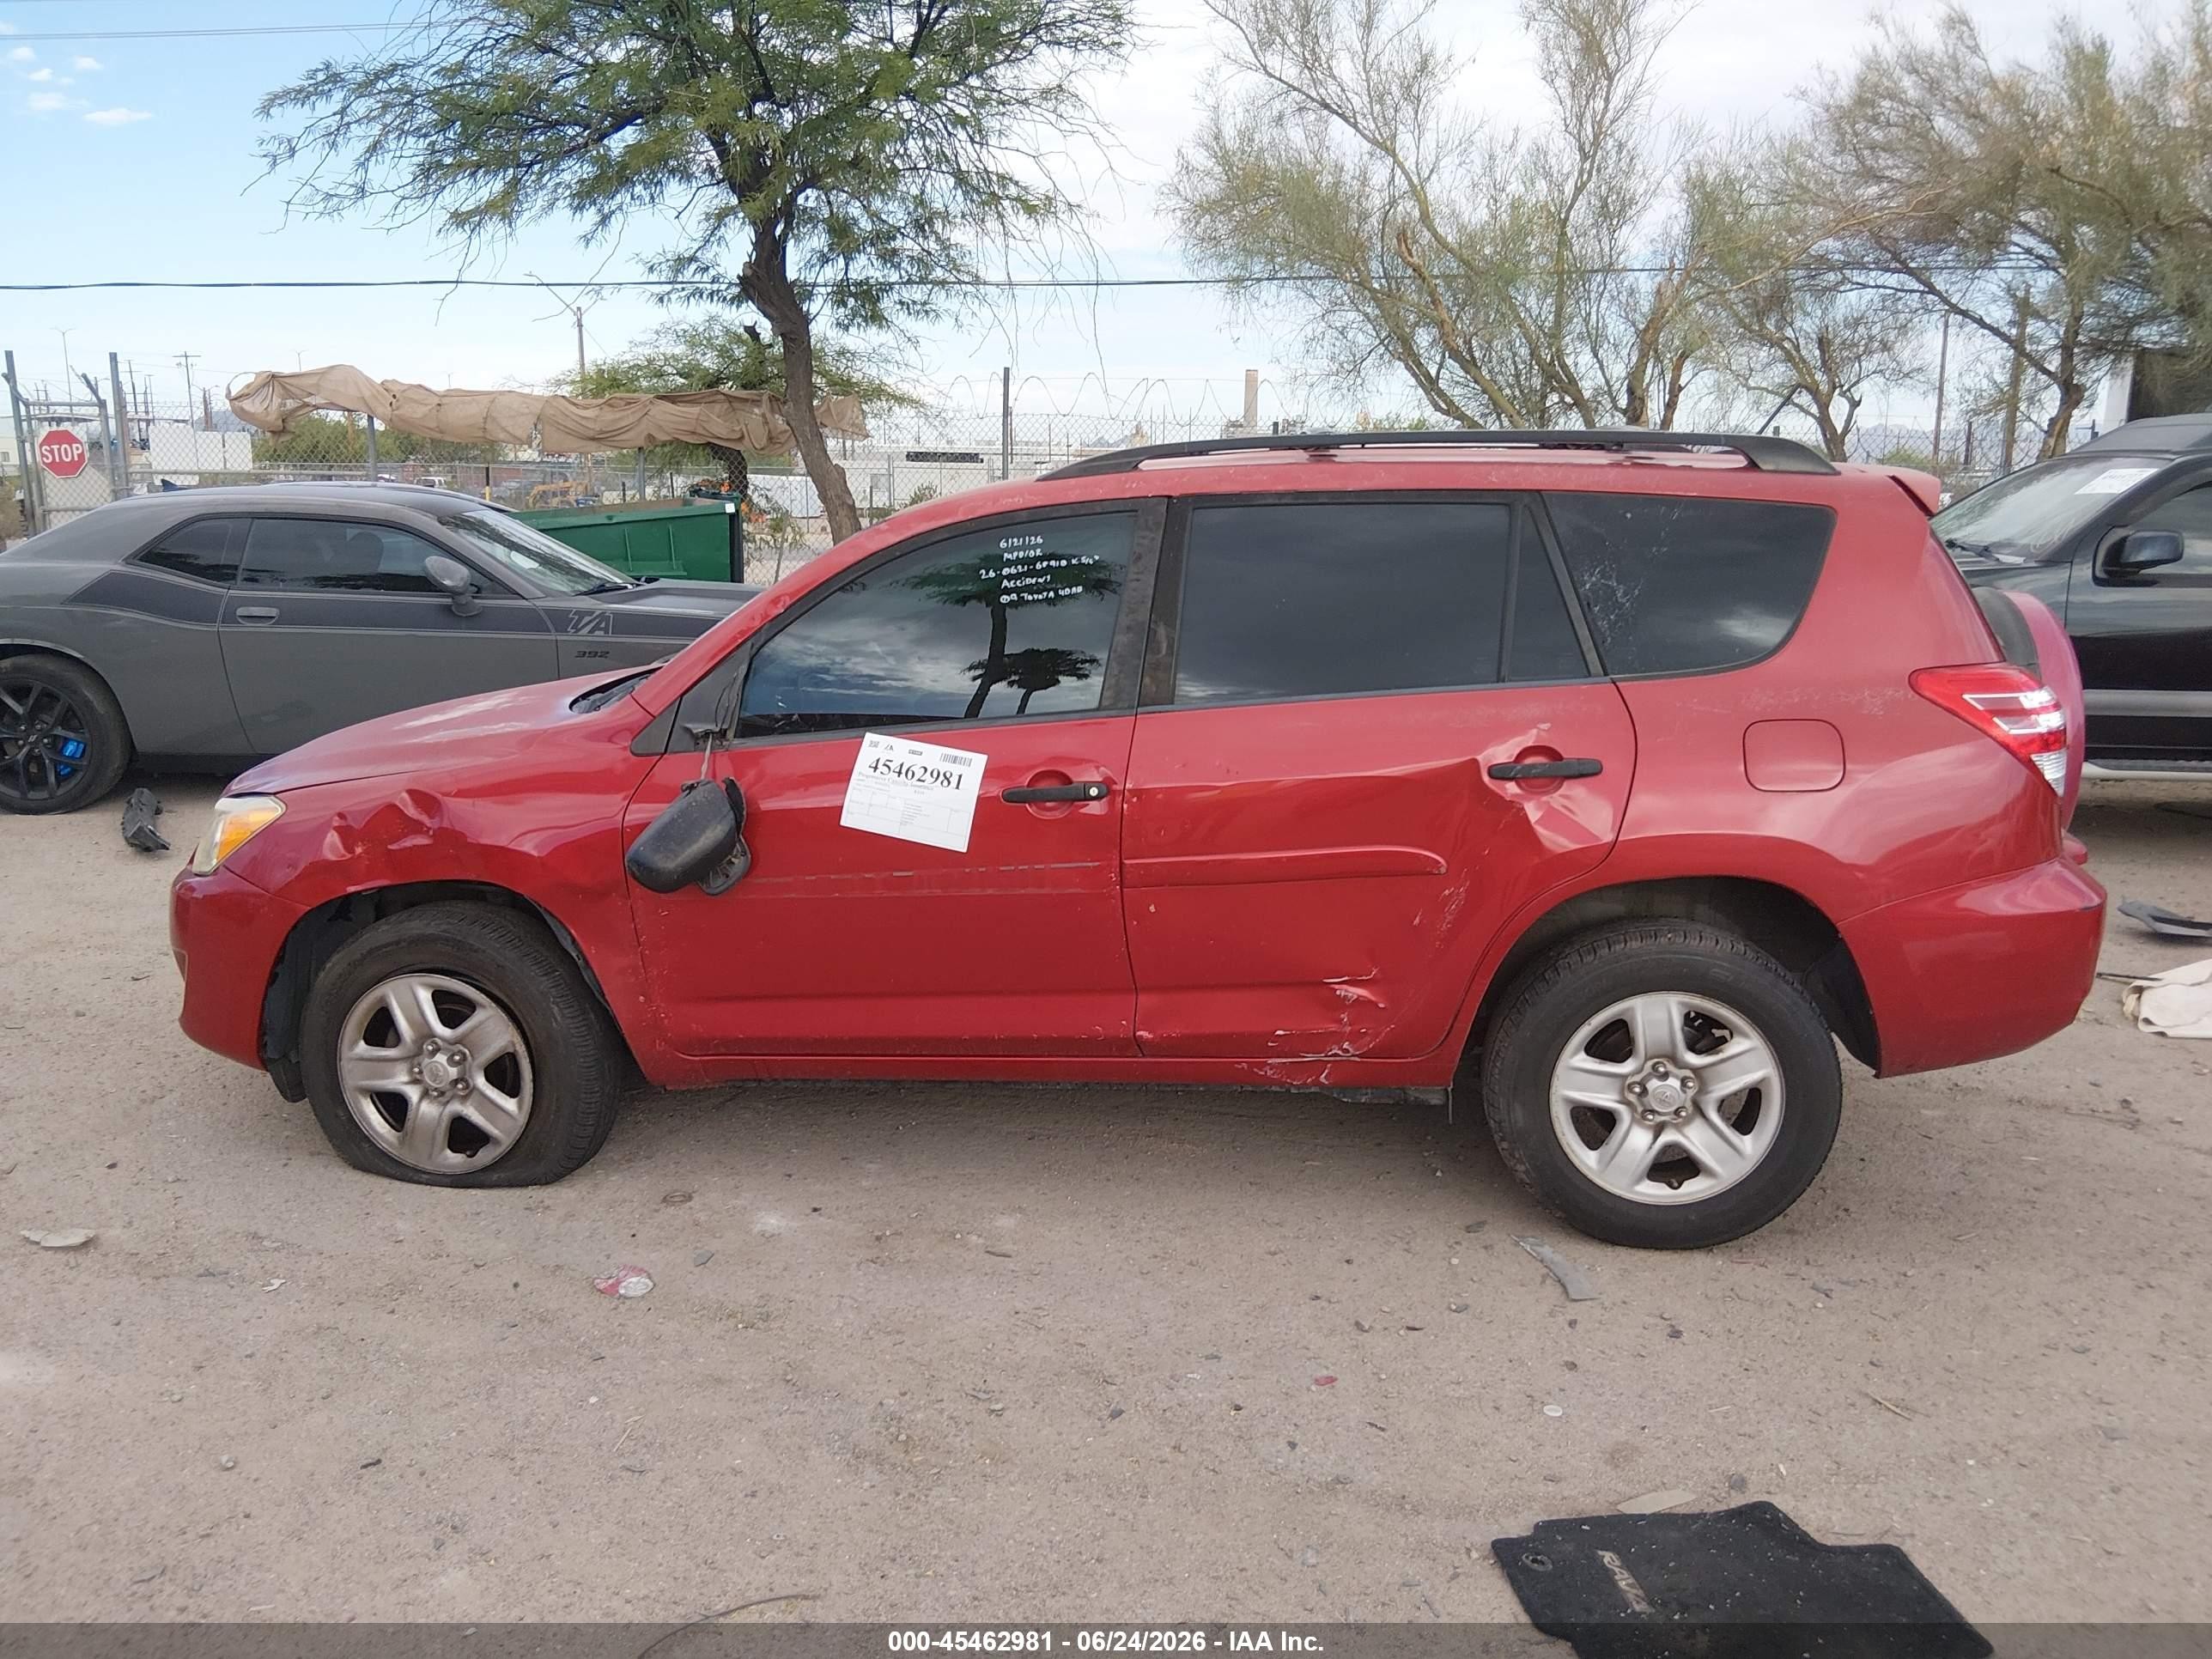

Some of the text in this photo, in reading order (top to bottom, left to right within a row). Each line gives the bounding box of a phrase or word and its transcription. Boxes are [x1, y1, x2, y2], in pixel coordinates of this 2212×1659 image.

[41, 443, 83, 464] STOP
[574, 650, 611, 659] 392
[868, 757, 963, 790] 45462981
